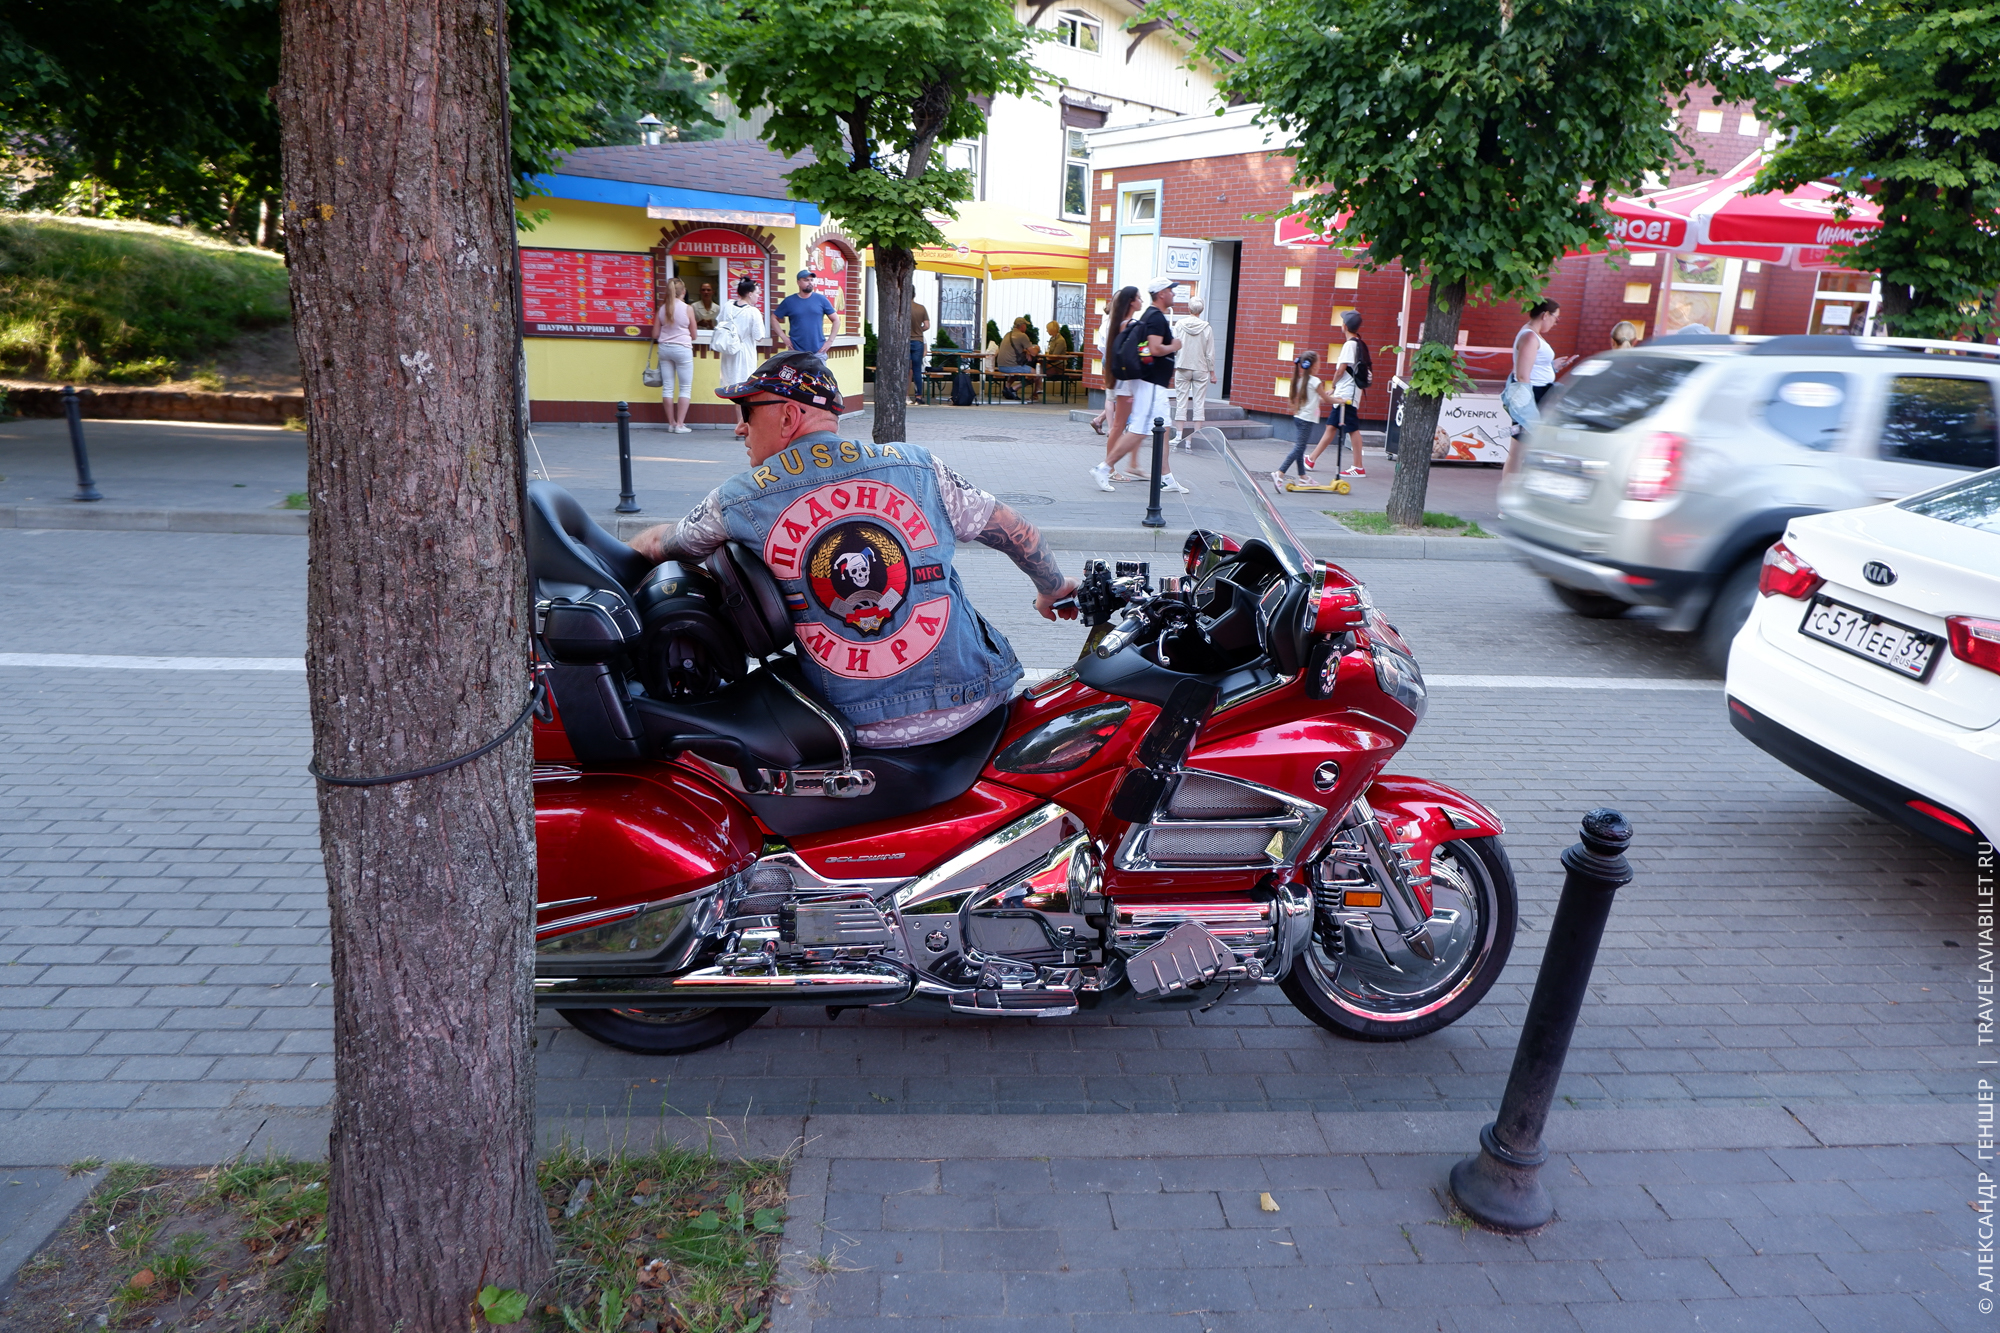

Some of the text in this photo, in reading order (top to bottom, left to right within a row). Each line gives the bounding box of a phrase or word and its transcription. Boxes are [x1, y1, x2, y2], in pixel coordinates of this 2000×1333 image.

[678, 242, 757, 254] ГЛИНТВЕЙН
[537, 324, 615, 333] ШАУРМА КУРИНАЯ
[752, 441, 903, 489] RUSSIA
[771, 486, 926, 569] ПАДОНКИ
[915, 566, 942, 581] MFC
[1864, 563, 1889, 584] KIA
[806, 614, 941, 672] МИРА
[1893, 654, 1911, 668] RUS
[825, 852, 906, 863] GOLDWING
